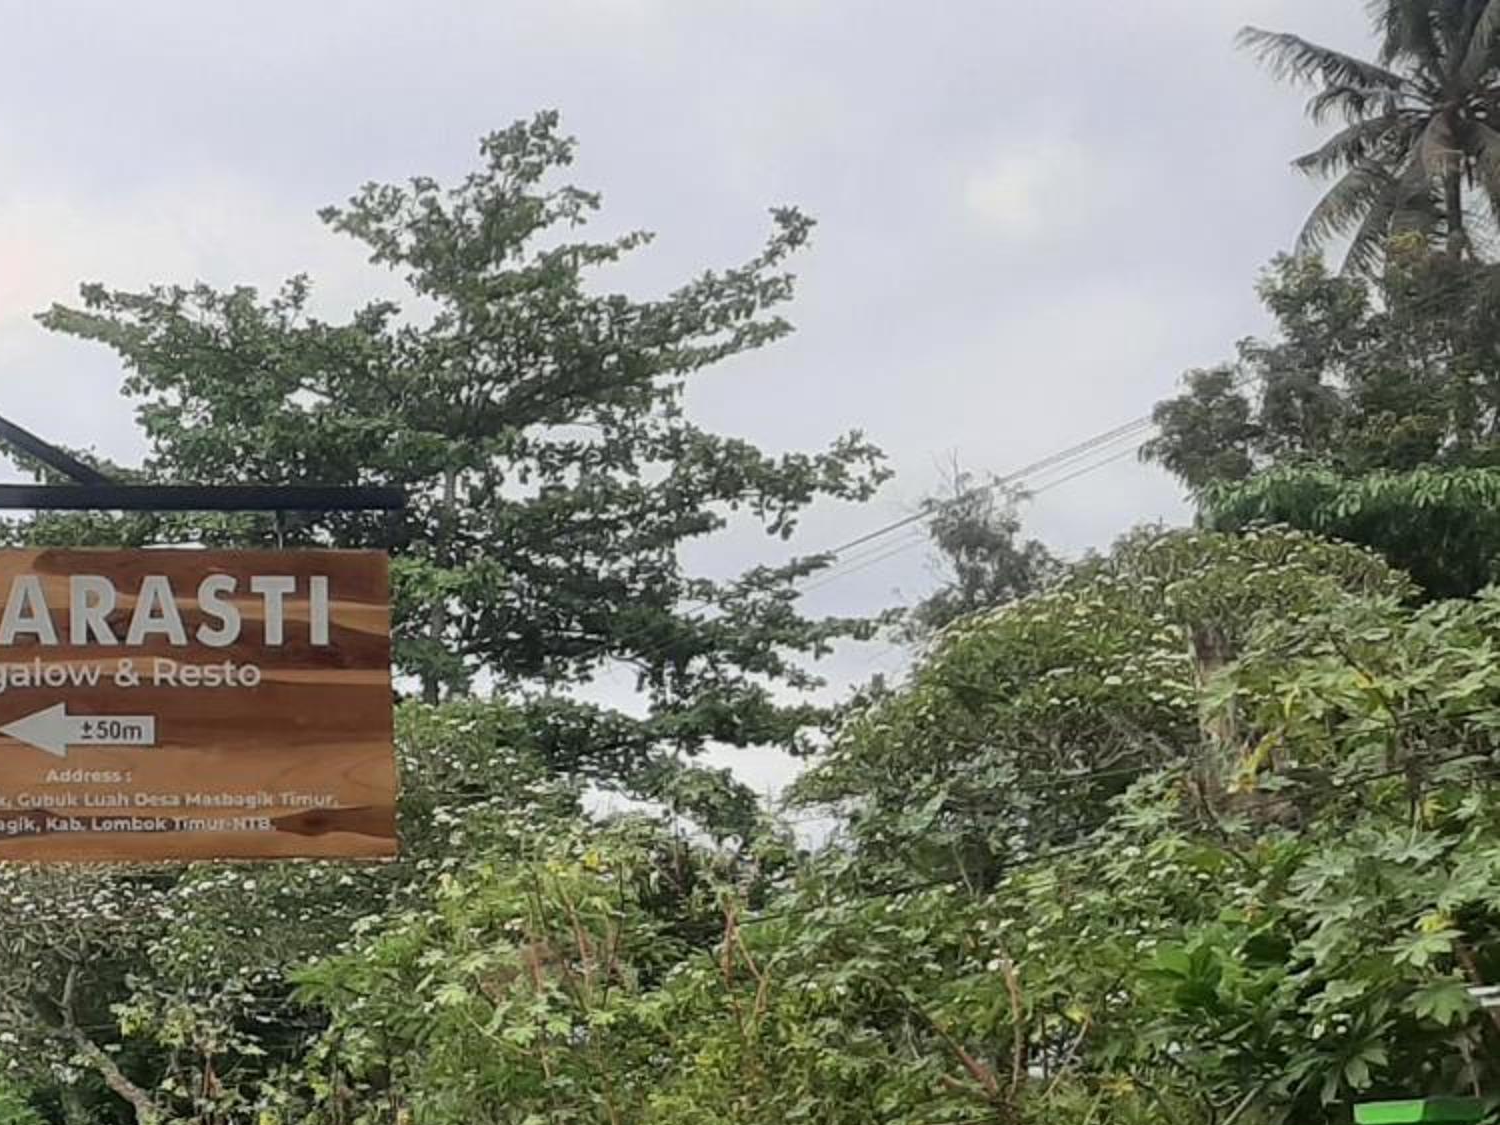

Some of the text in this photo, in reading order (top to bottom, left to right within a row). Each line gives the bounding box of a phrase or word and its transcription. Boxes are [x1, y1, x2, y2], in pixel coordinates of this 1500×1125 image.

[115, 657, 140, 687] &
[154, 657, 261, 687] Resto
[80, 720, 143, 741] ±50m
[46, 769, 120, 783] Address
[18, 793, 79, 808] Gubuk
[85, 793, 129, 807] Luah
[135, 793, 180, 807] Desa
[187, 793, 274, 809] Masbagik
[46, 817, 85, 832] Kab.
[90, 817, 167, 831] Lombok
